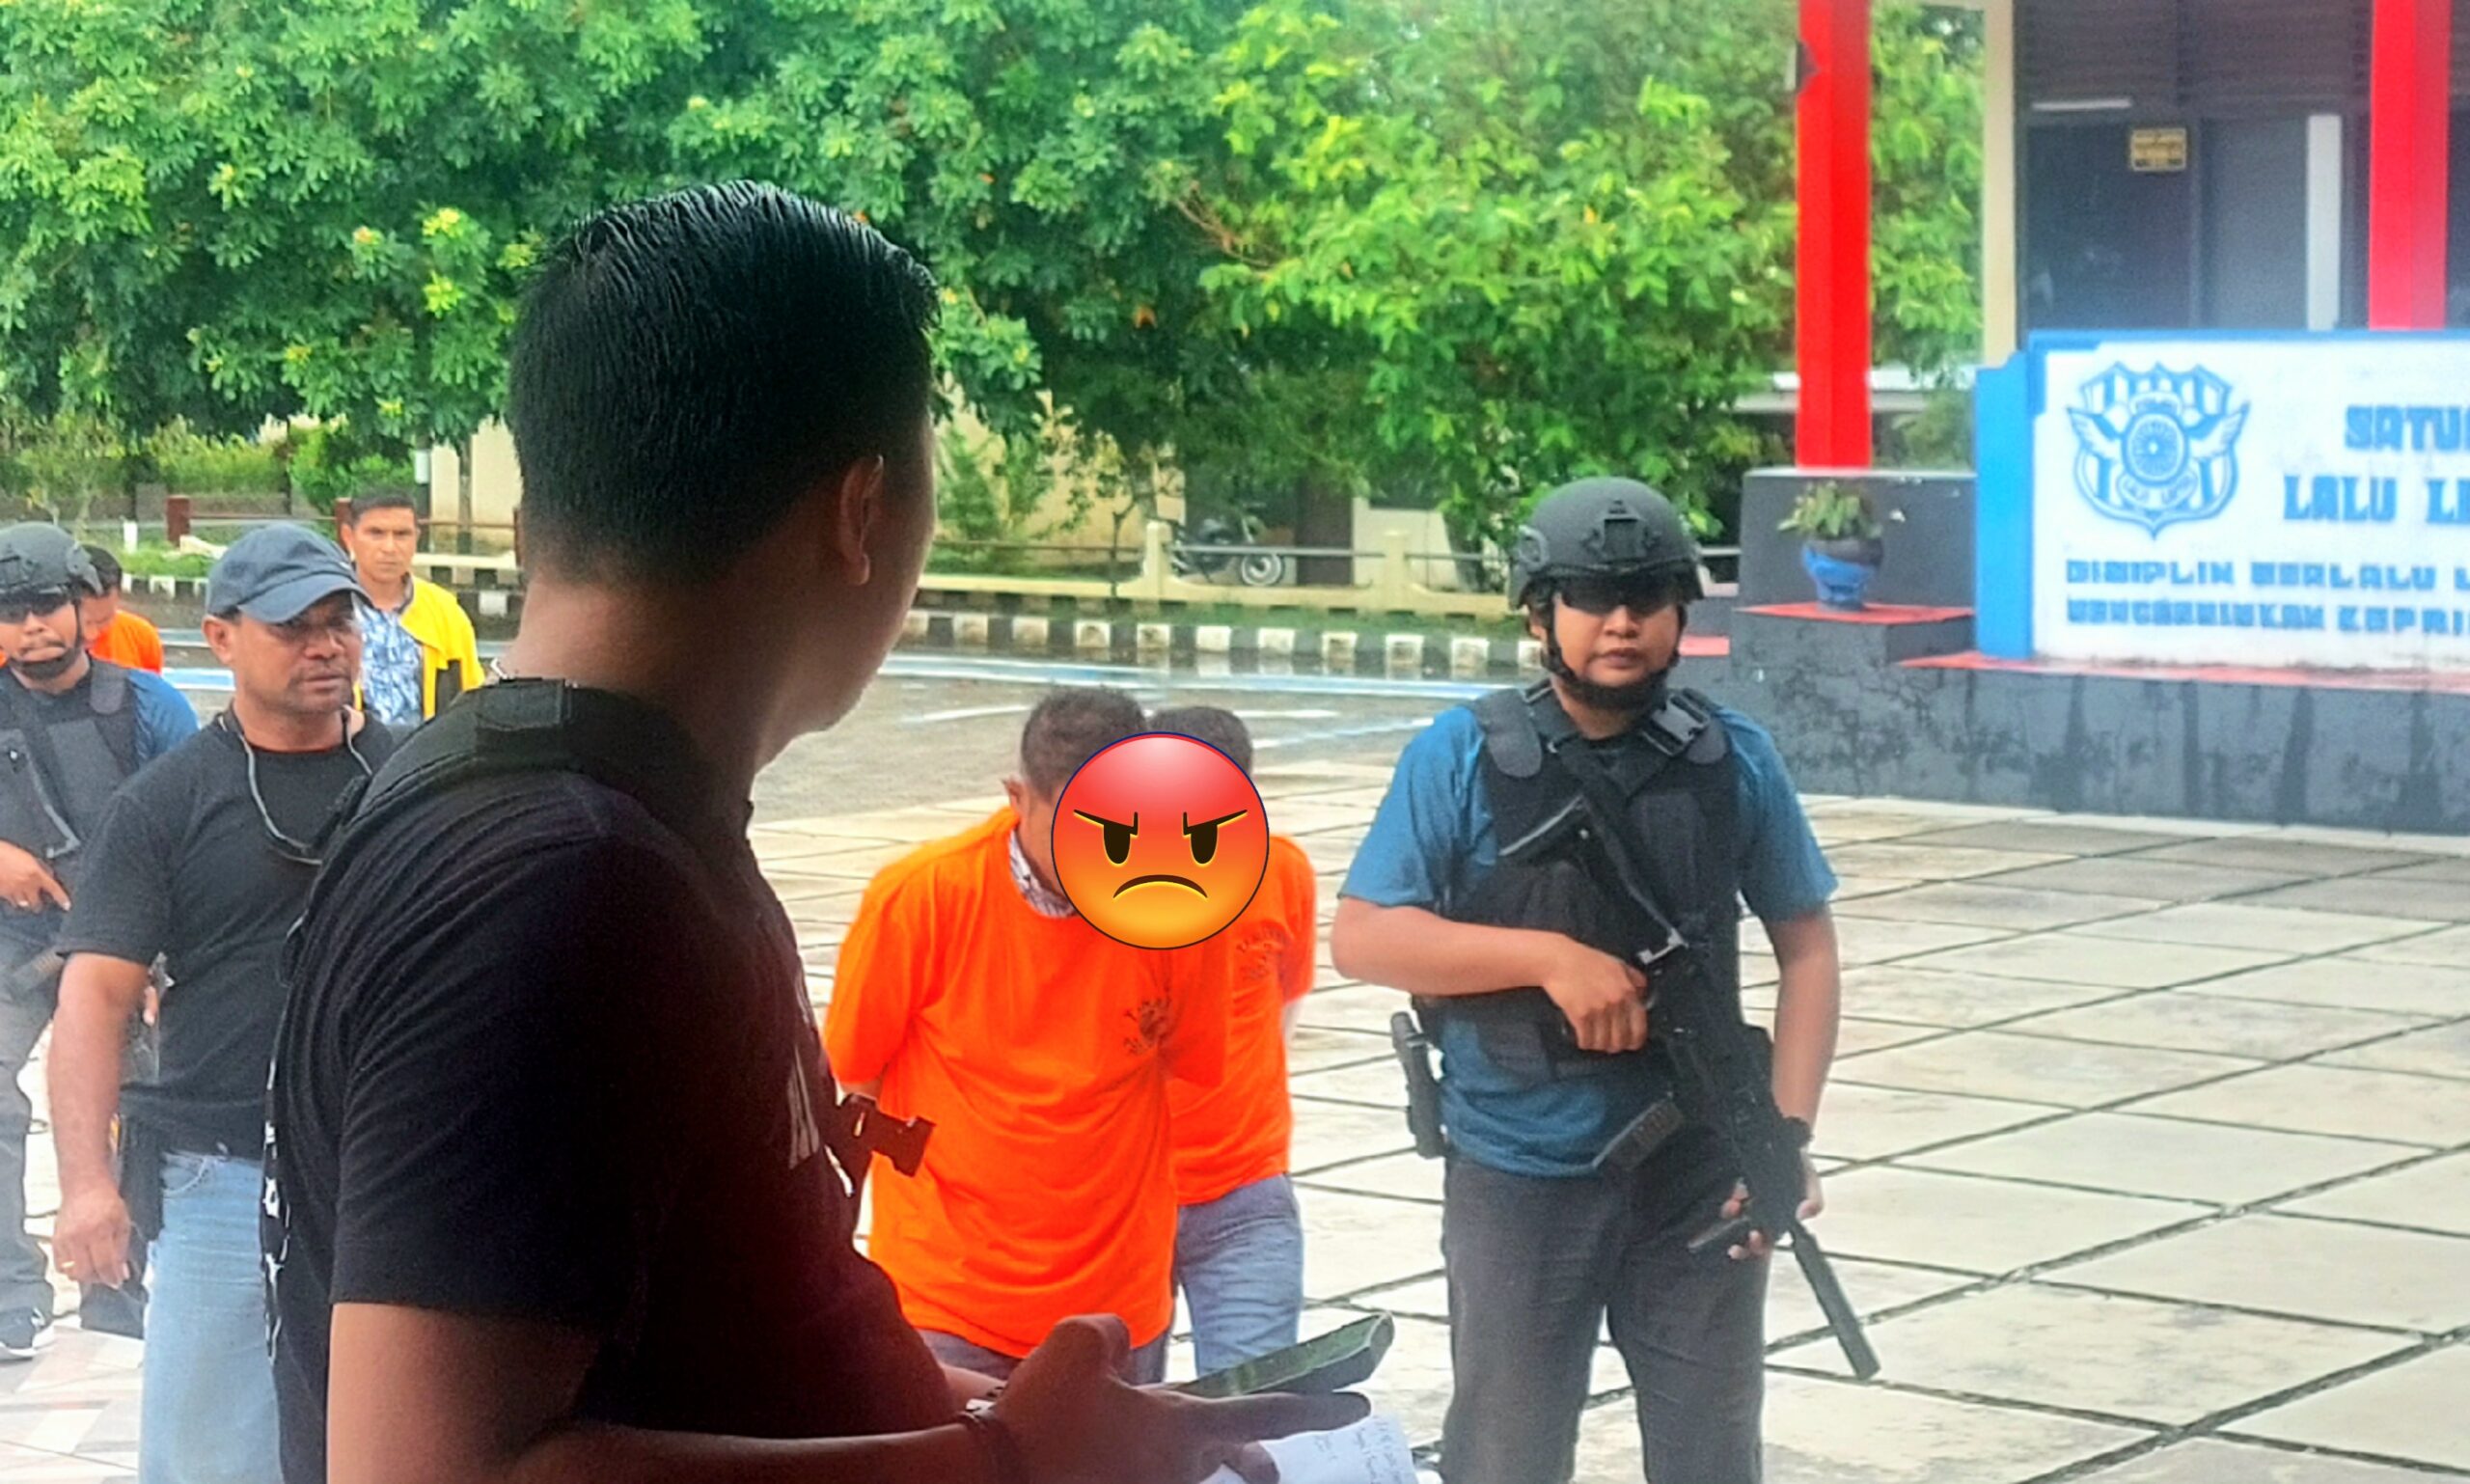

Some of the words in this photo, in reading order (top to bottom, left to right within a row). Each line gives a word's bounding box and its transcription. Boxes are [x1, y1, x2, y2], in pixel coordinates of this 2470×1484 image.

[2345, 404, 2470, 453] SATU
[2283, 475, 2397, 523] LALU
[2067, 560, 2234, 585] DISIPLIN
[2338, 606, 2470, 636] KEPRI
